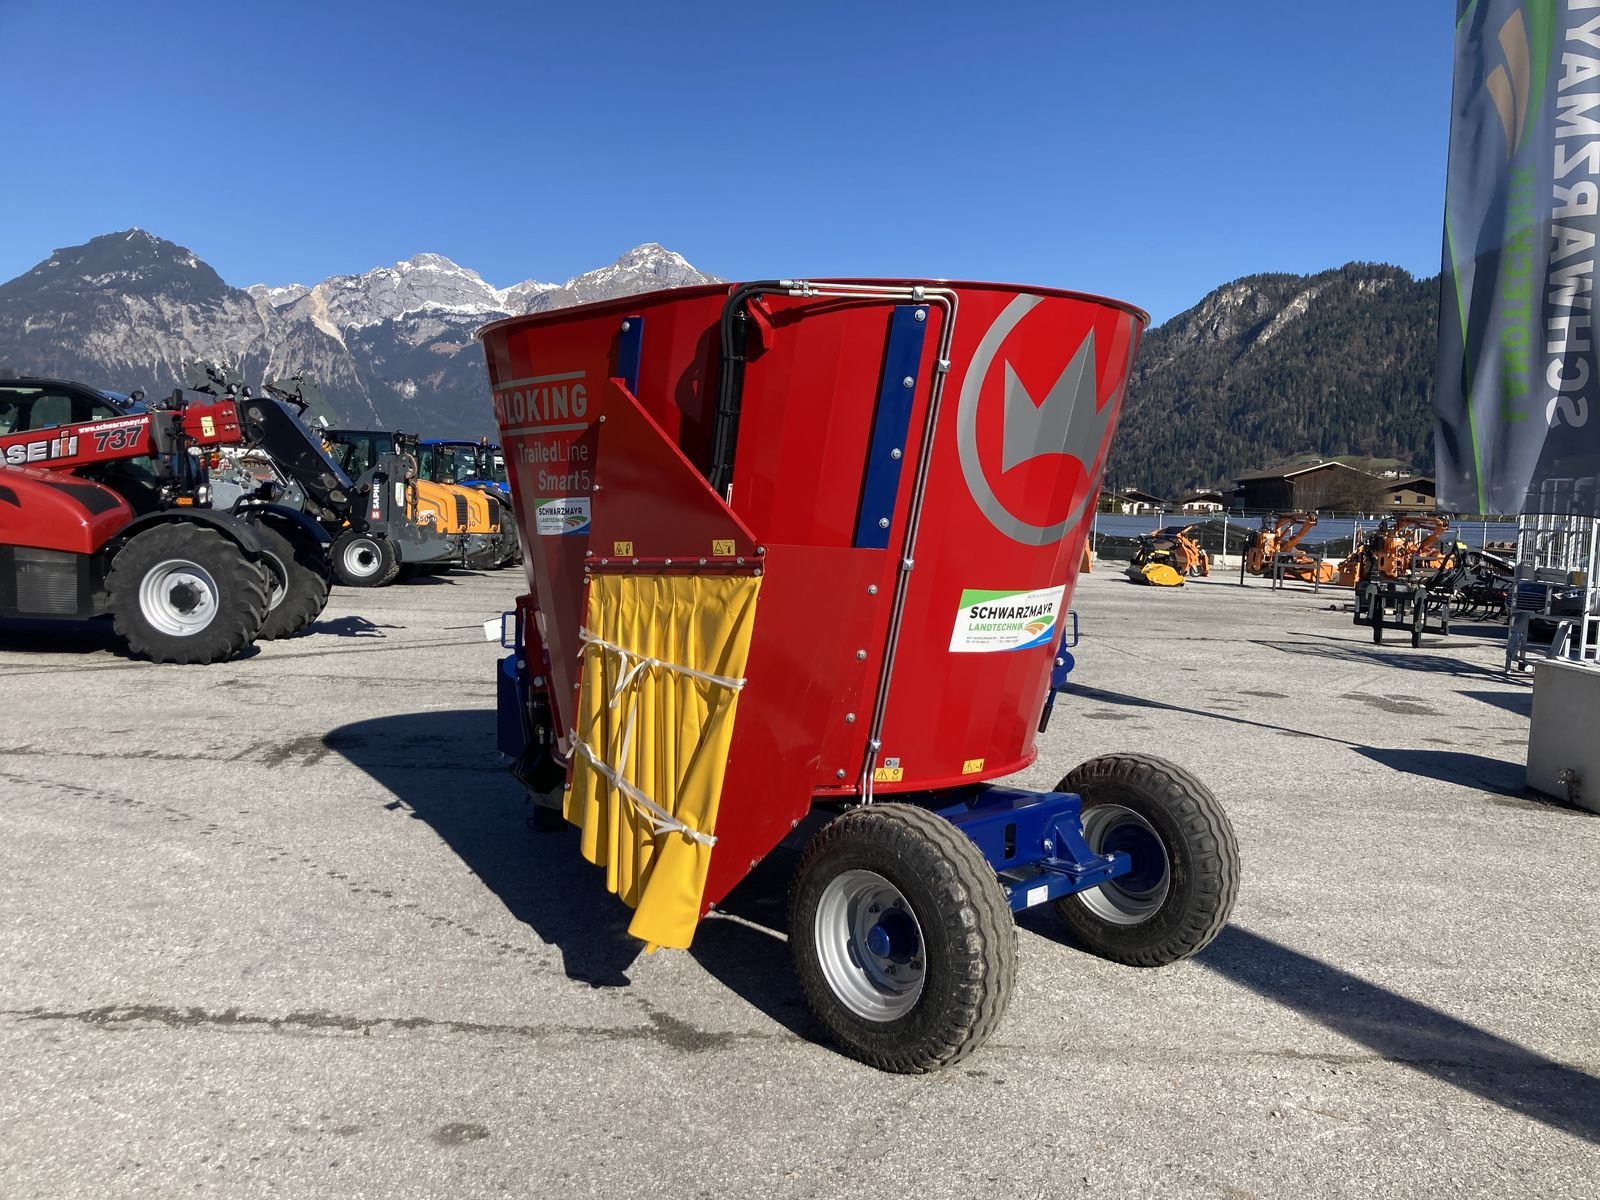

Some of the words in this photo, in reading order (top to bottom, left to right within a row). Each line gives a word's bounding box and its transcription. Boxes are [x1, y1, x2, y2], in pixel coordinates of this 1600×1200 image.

[78, 416, 150, 434] www.schwarzmayr.at
[93, 425, 143, 453] 737
[518, 439, 589, 464] TrailedLine
[538, 507, 583, 516] SCHWARZMAYR
[969, 602, 1053, 620] SCHWARZMAYR
[968, 622, 1025, 632] LANDTECHNIK
